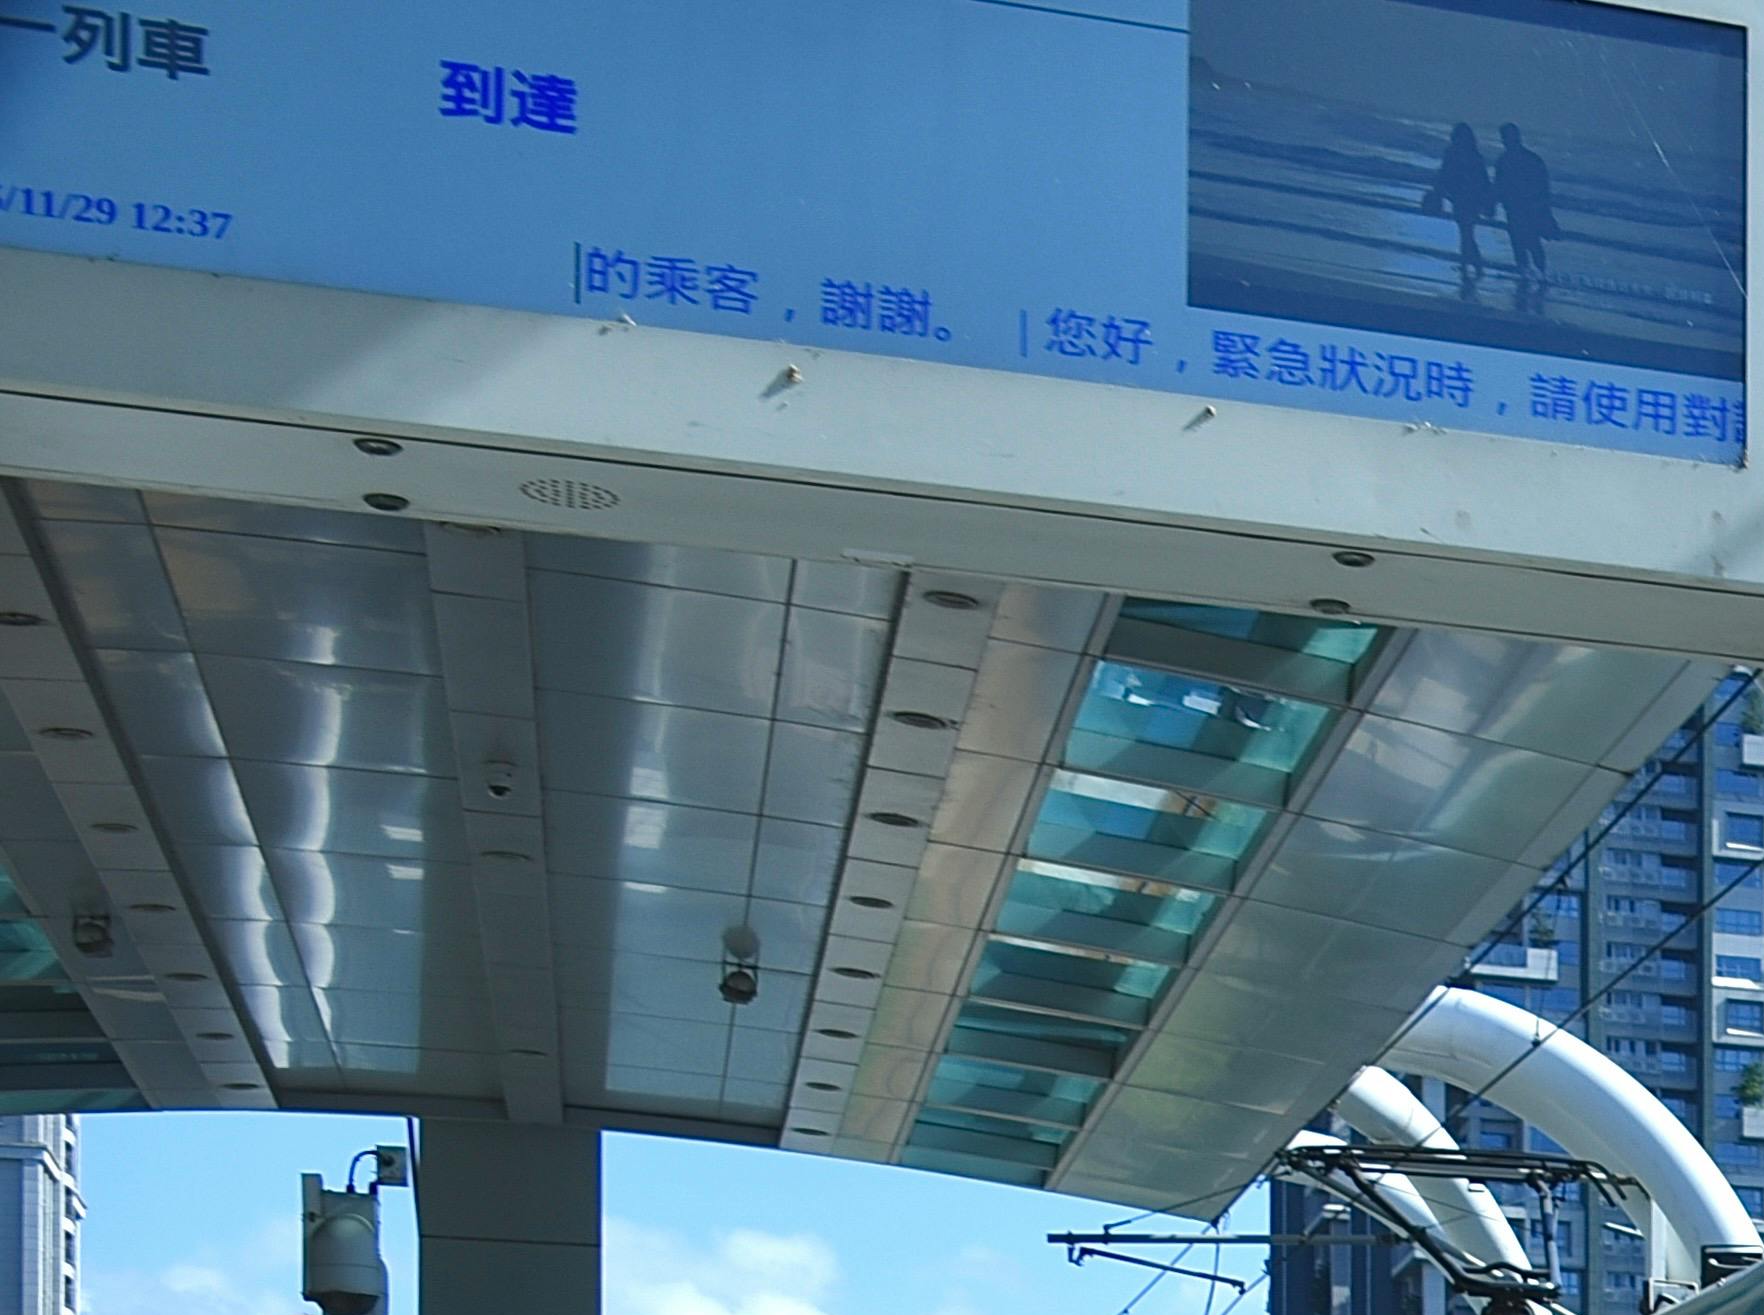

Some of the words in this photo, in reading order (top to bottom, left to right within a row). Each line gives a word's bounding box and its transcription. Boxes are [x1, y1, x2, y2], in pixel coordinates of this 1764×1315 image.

[0, 5, 210, 80] 一列車
[439, 59, 578, 135] 到達
[0, 185, 117, 225] /11/29
[131, 202, 233, 240] 12:37
[1046, 307, 1744, 444] 您好，緊急狀況時，請使用對
